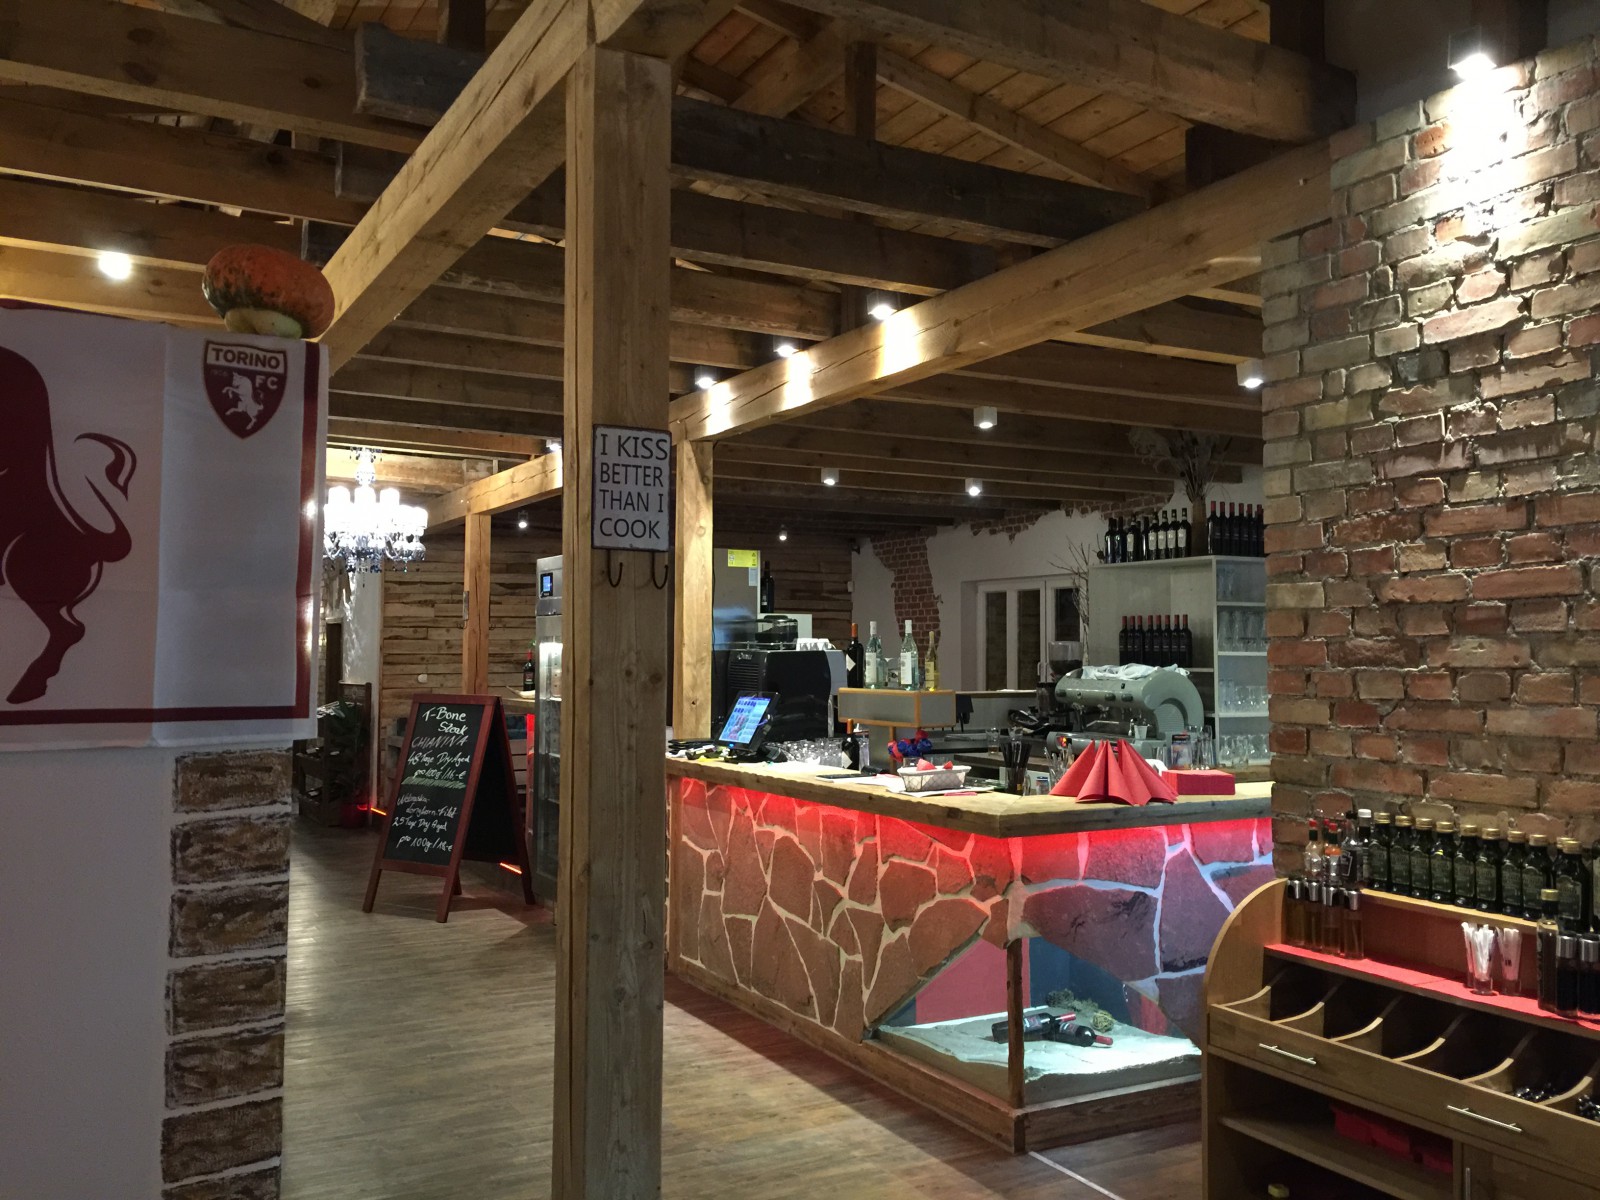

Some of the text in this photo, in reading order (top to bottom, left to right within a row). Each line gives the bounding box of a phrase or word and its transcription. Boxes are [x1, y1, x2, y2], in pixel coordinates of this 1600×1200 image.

[212, 348, 280, 370] TORINO
[255, 375, 278, 390] FC
[600, 433, 668, 461] I KISS
[600, 462, 664, 488] BETTER
[599, 489, 664, 513] THAN I
[600, 517, 660, 539] COOK
[422, 706, 467, 722] T-Bone
[438, 721, 468, 736] Steak
[411, 735, 469, 749] CHIANINA
[437, 751, 453, 770] Dry
[451, 752, 471, 767] Aged
[418, 819, 430, 832] Dry
[431, 820, 448, 832] Aged
